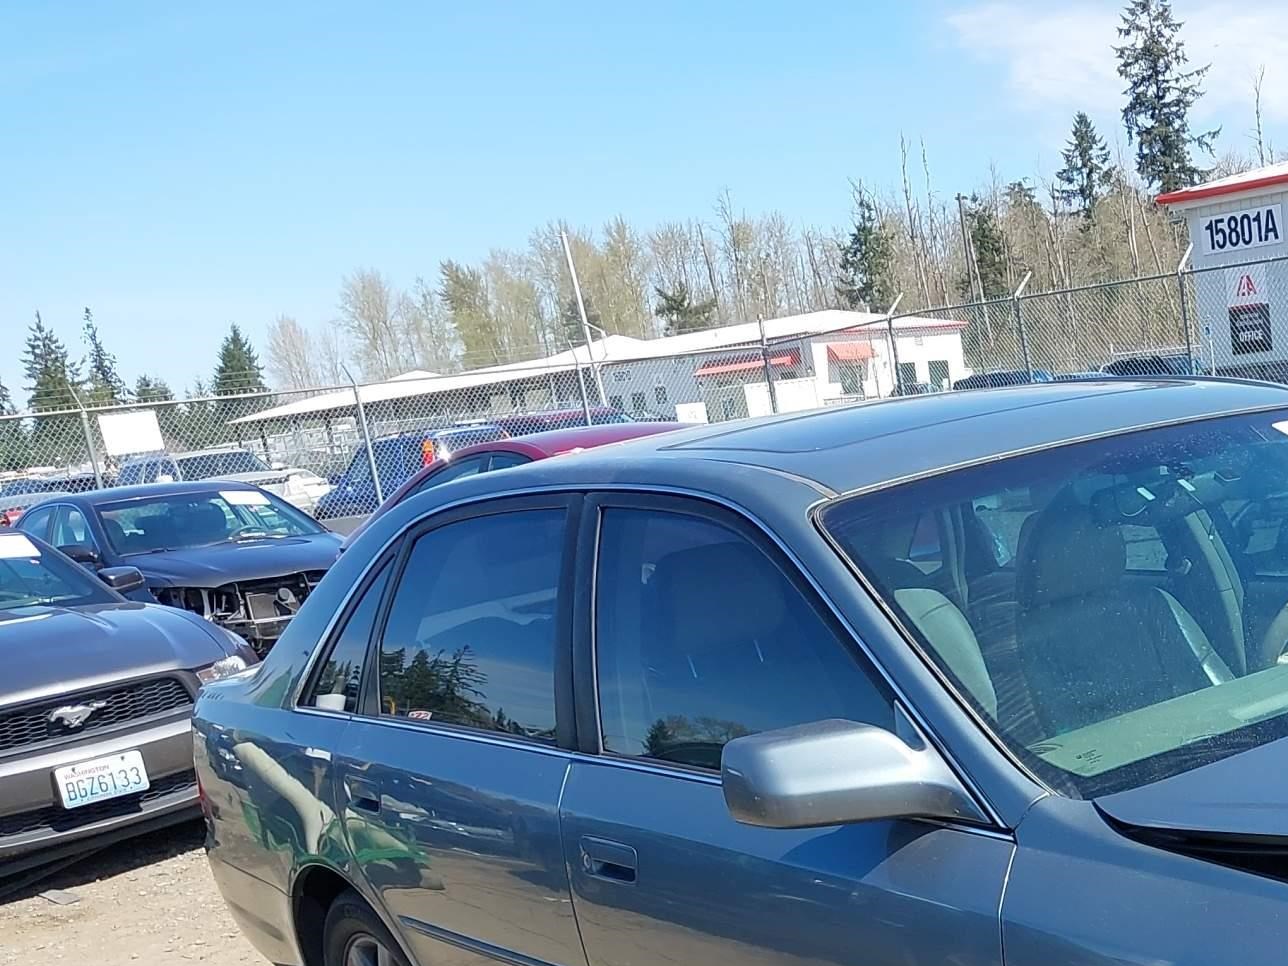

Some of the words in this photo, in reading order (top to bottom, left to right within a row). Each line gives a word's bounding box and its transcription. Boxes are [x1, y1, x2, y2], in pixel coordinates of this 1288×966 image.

[1204, 208, 1279, 251] 15801A
[63, 764, 110, 780] WASHINGTON
[65, 766, 142, 802] BGZ6133
